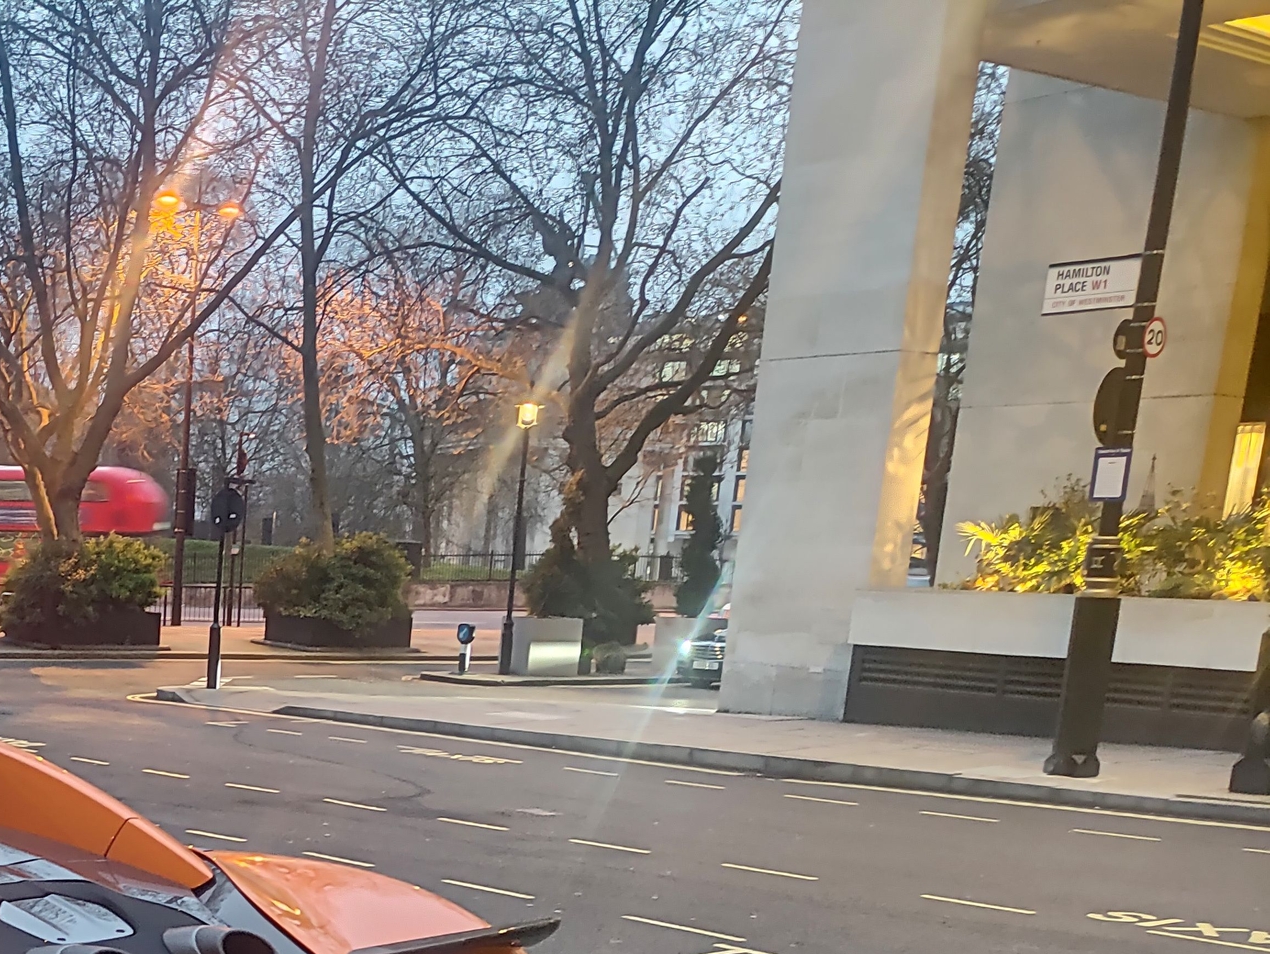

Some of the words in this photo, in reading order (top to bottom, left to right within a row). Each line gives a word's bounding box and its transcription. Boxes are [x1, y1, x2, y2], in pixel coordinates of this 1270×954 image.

[1056, 265, 1111, 281] HAMILTON
[1053, 280, 1088, 294] PLACE
[1091, 279, 1108, 291] W1
[1146, 328, 1164, 347] 20
